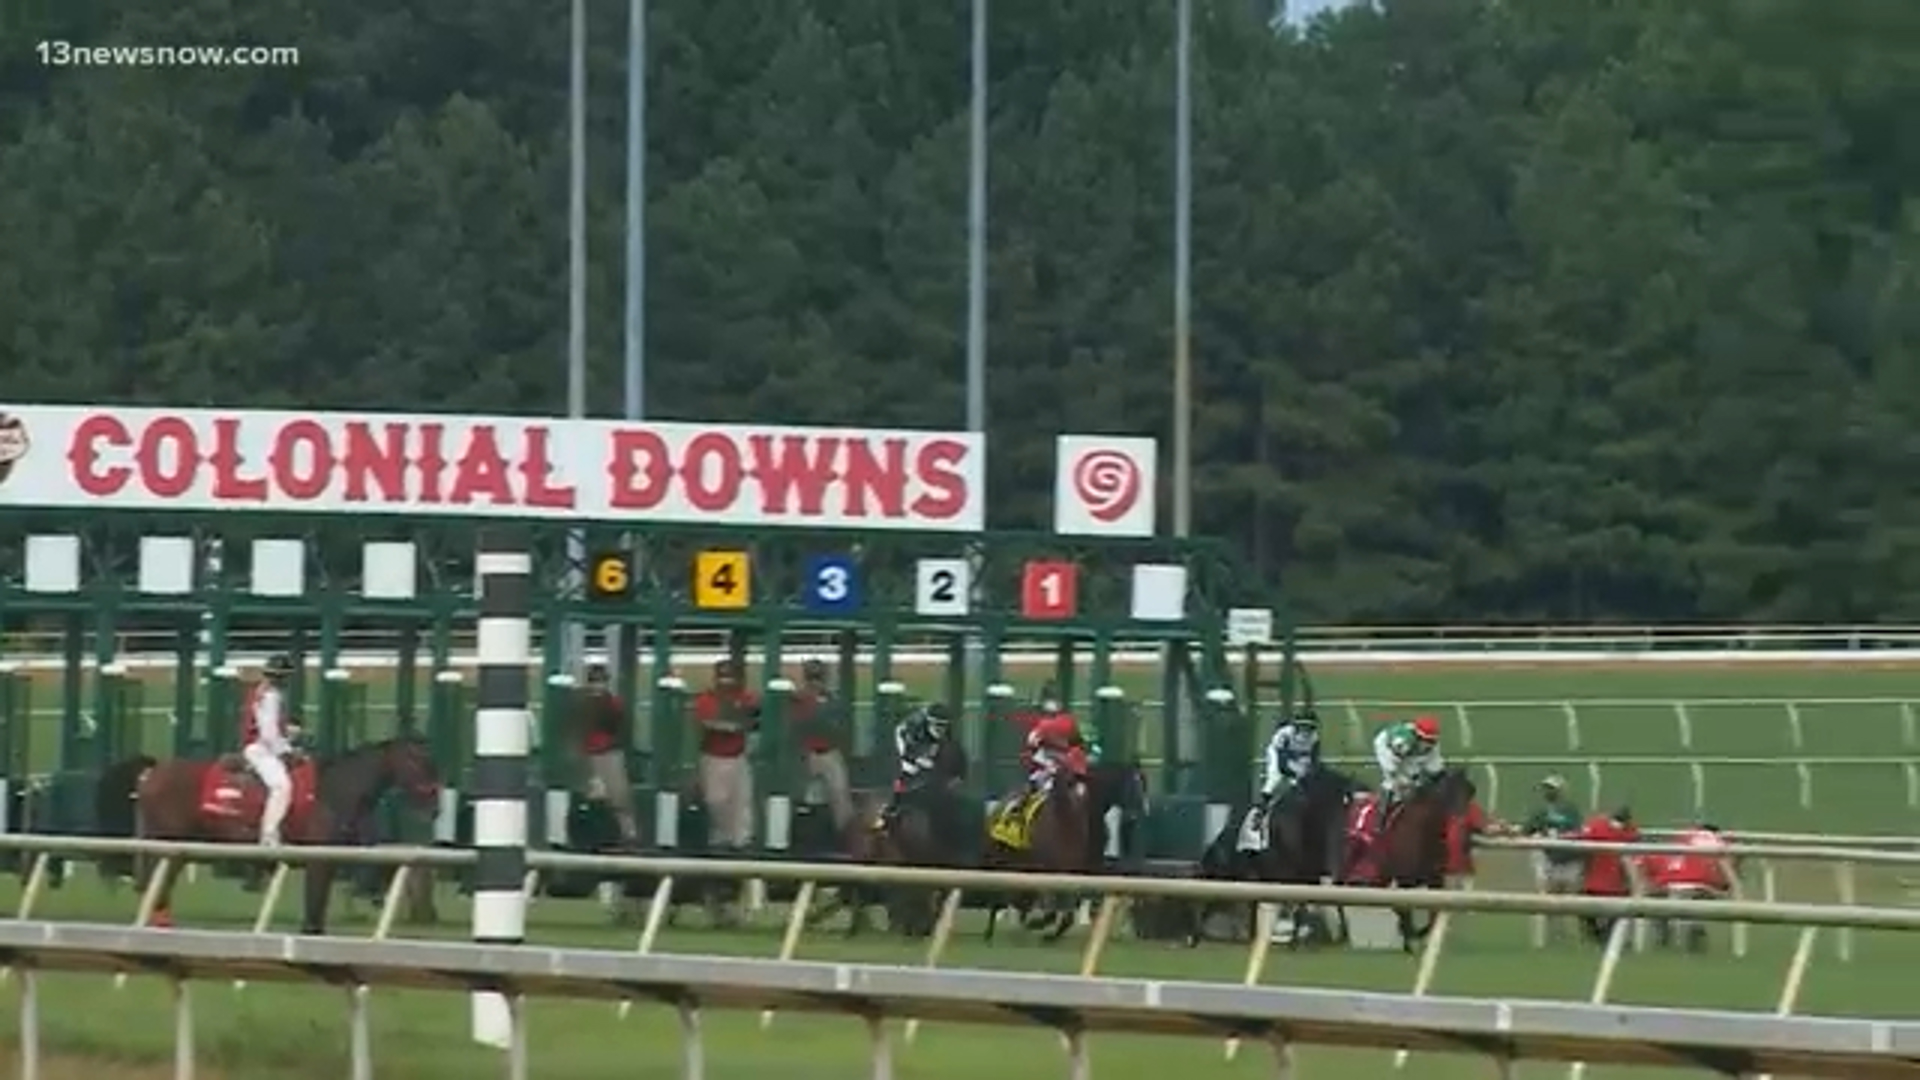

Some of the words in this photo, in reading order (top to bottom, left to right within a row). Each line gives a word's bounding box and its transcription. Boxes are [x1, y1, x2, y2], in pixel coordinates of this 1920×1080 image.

[68, 414, 576, 509] COLONIAL
[609, 430, 968, 519] DOWNS
[596, 559, 627, 593] 6
[710, 563, 738, 596] 4
[818, 567, 848, 602] 3
[930, 569, 956, 604] 2
[1040, 574, 1061, 607] 1
